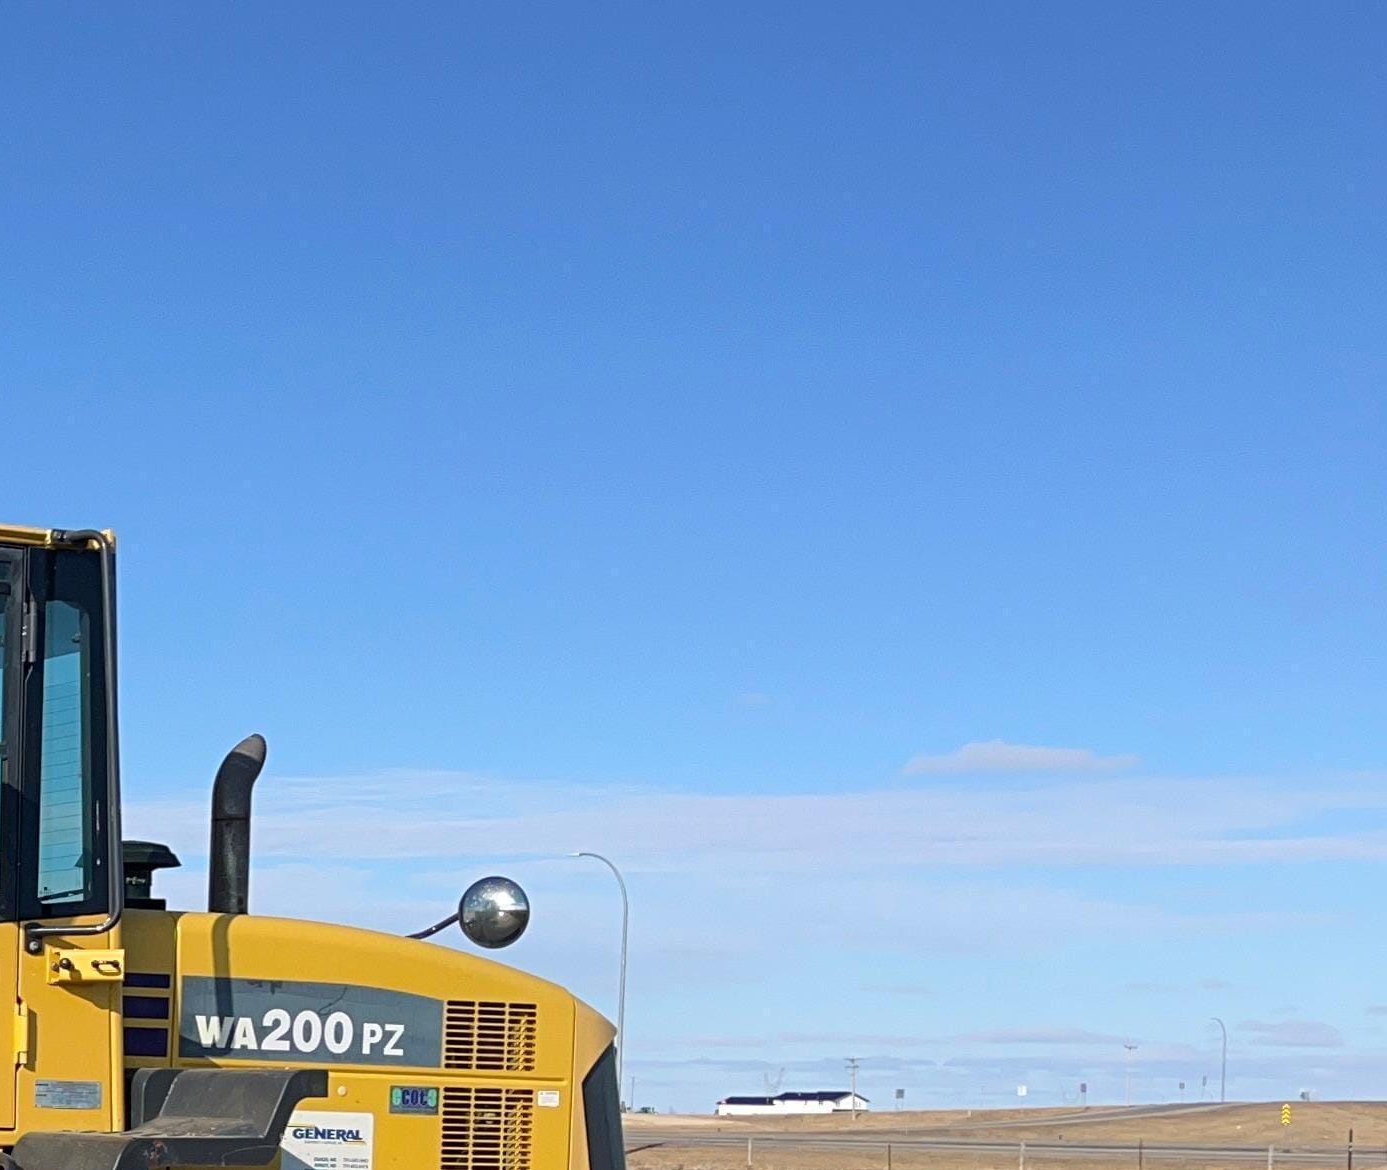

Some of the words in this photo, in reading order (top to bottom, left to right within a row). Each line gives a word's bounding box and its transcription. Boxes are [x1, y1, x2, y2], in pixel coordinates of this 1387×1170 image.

[195, 1008, 354, 1054] WA200
[362, 1022, 406, 1057] PZ
[292, 1127, 364, 1142] GENERAL
